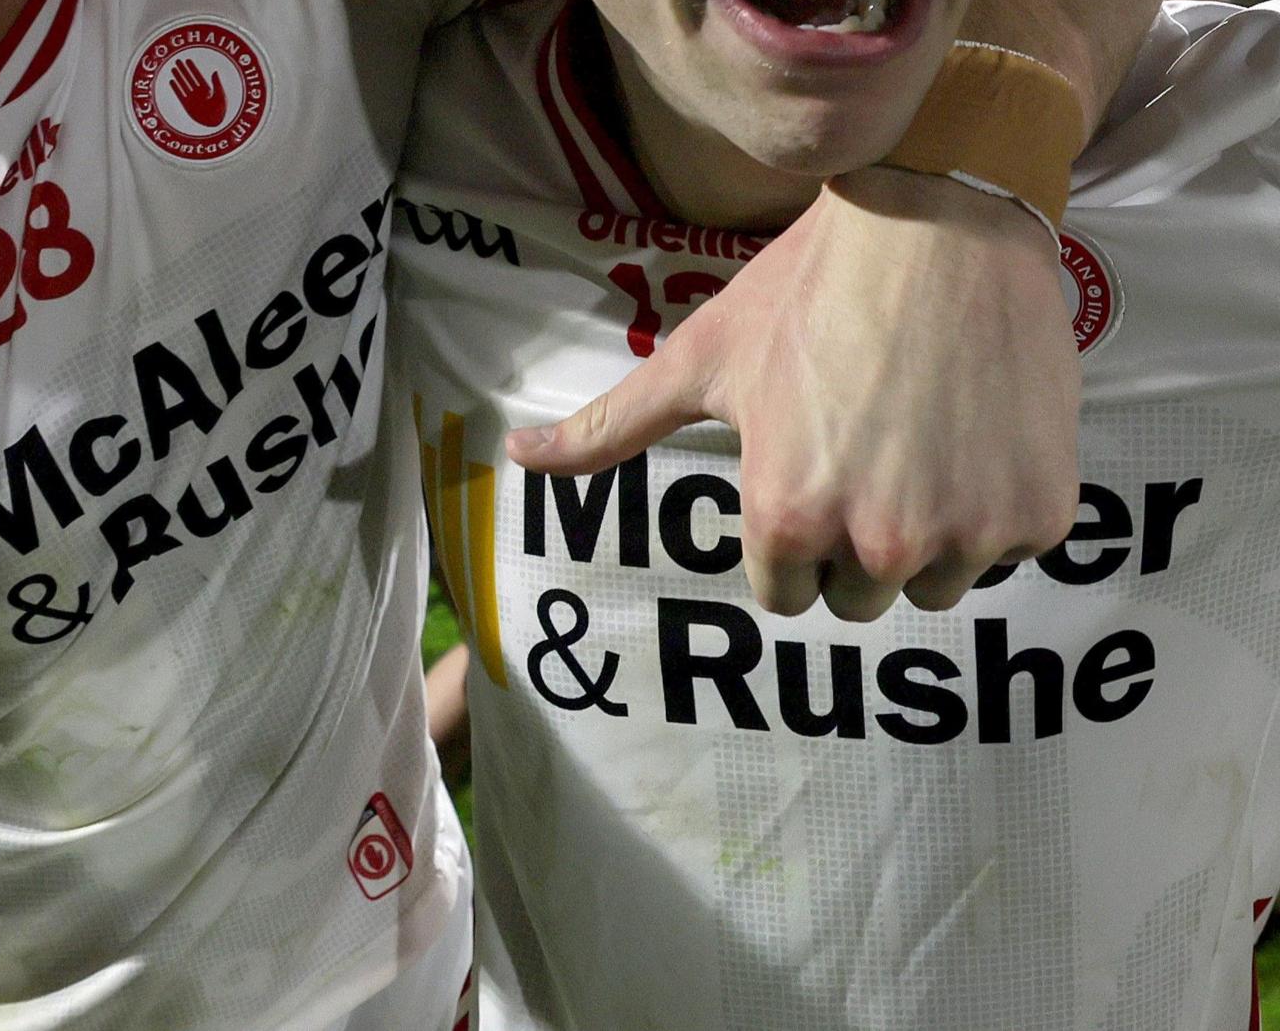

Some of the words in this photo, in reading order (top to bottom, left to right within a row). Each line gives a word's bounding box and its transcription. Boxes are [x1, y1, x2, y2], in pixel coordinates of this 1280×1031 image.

[6, 572, 95, 645] &
[99, 313, 378, 603] Rush
[526, 588, 629, 717] &
[657, 597, 1157, 746] Rushe
